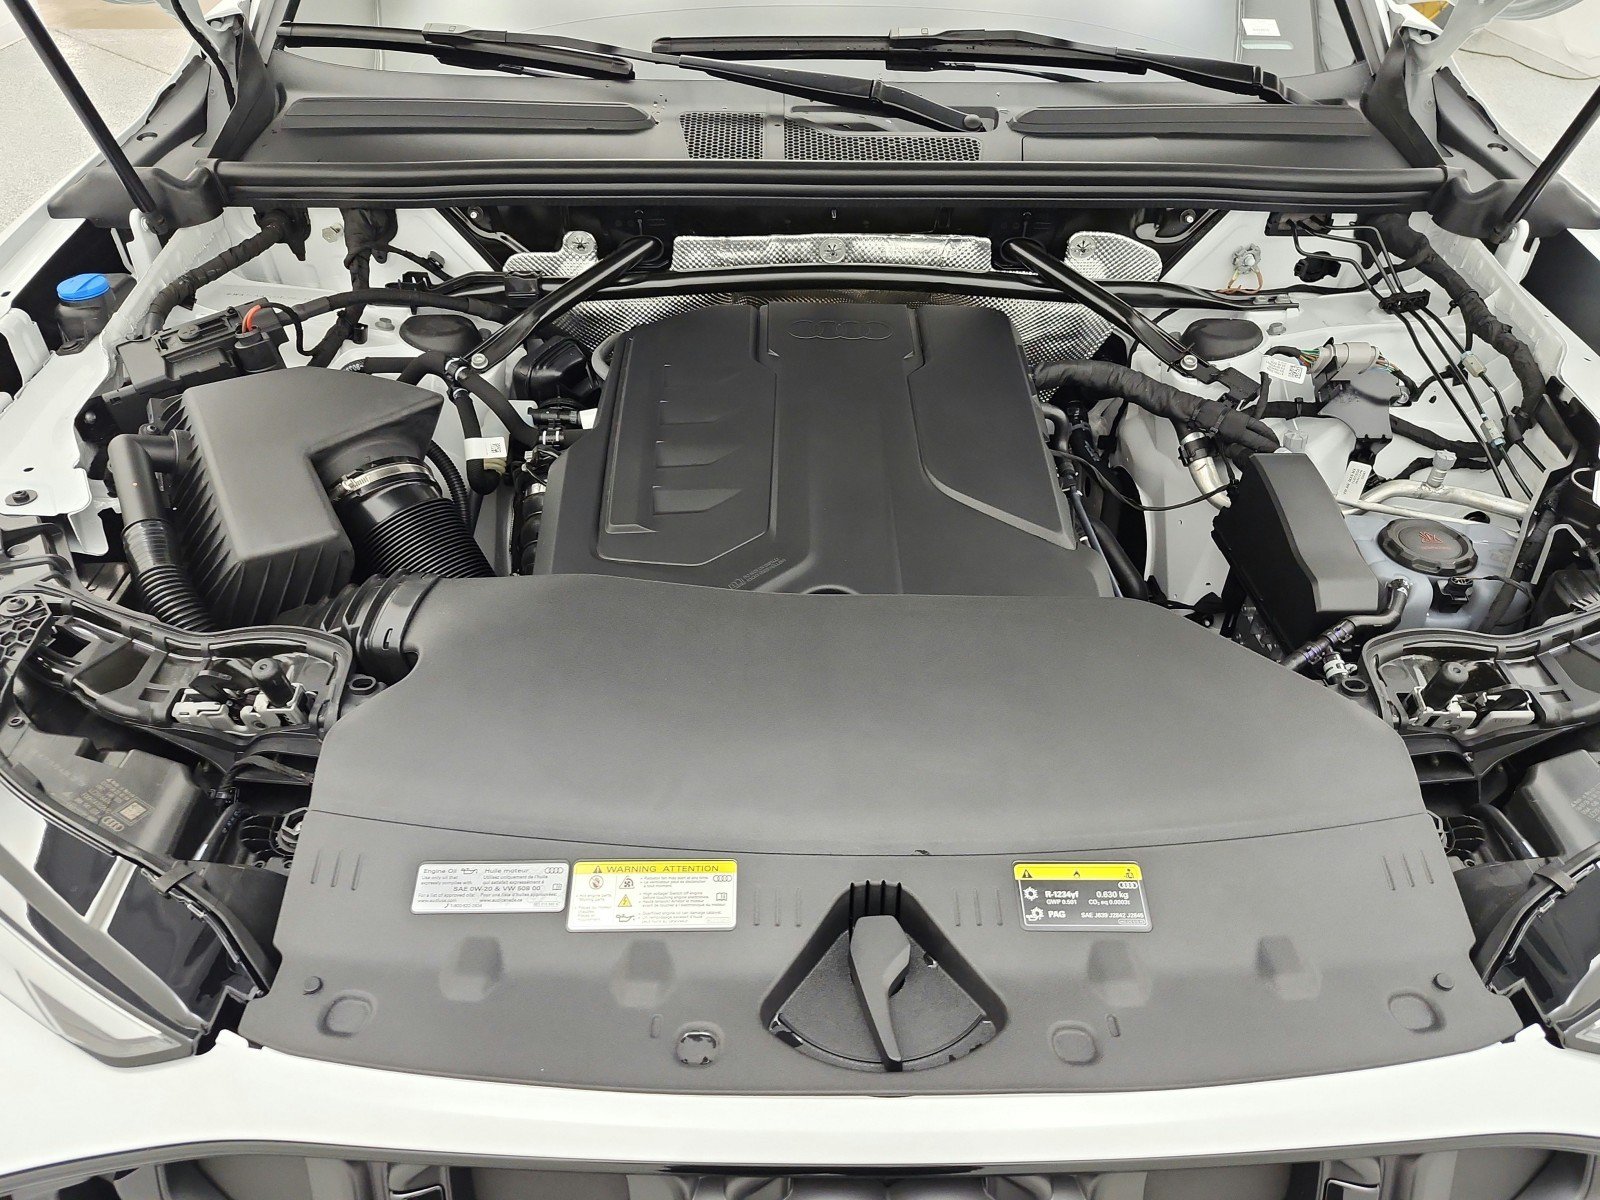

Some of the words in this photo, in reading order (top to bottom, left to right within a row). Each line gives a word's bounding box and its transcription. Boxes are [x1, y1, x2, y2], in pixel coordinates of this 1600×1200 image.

[1044, 890, 1079, 899] R-1234yf
[1095, 890, 1118, 898] 0.630
[1118, 890, 1129, 899] kg
[1047, 910, 1067, 918] PAG
